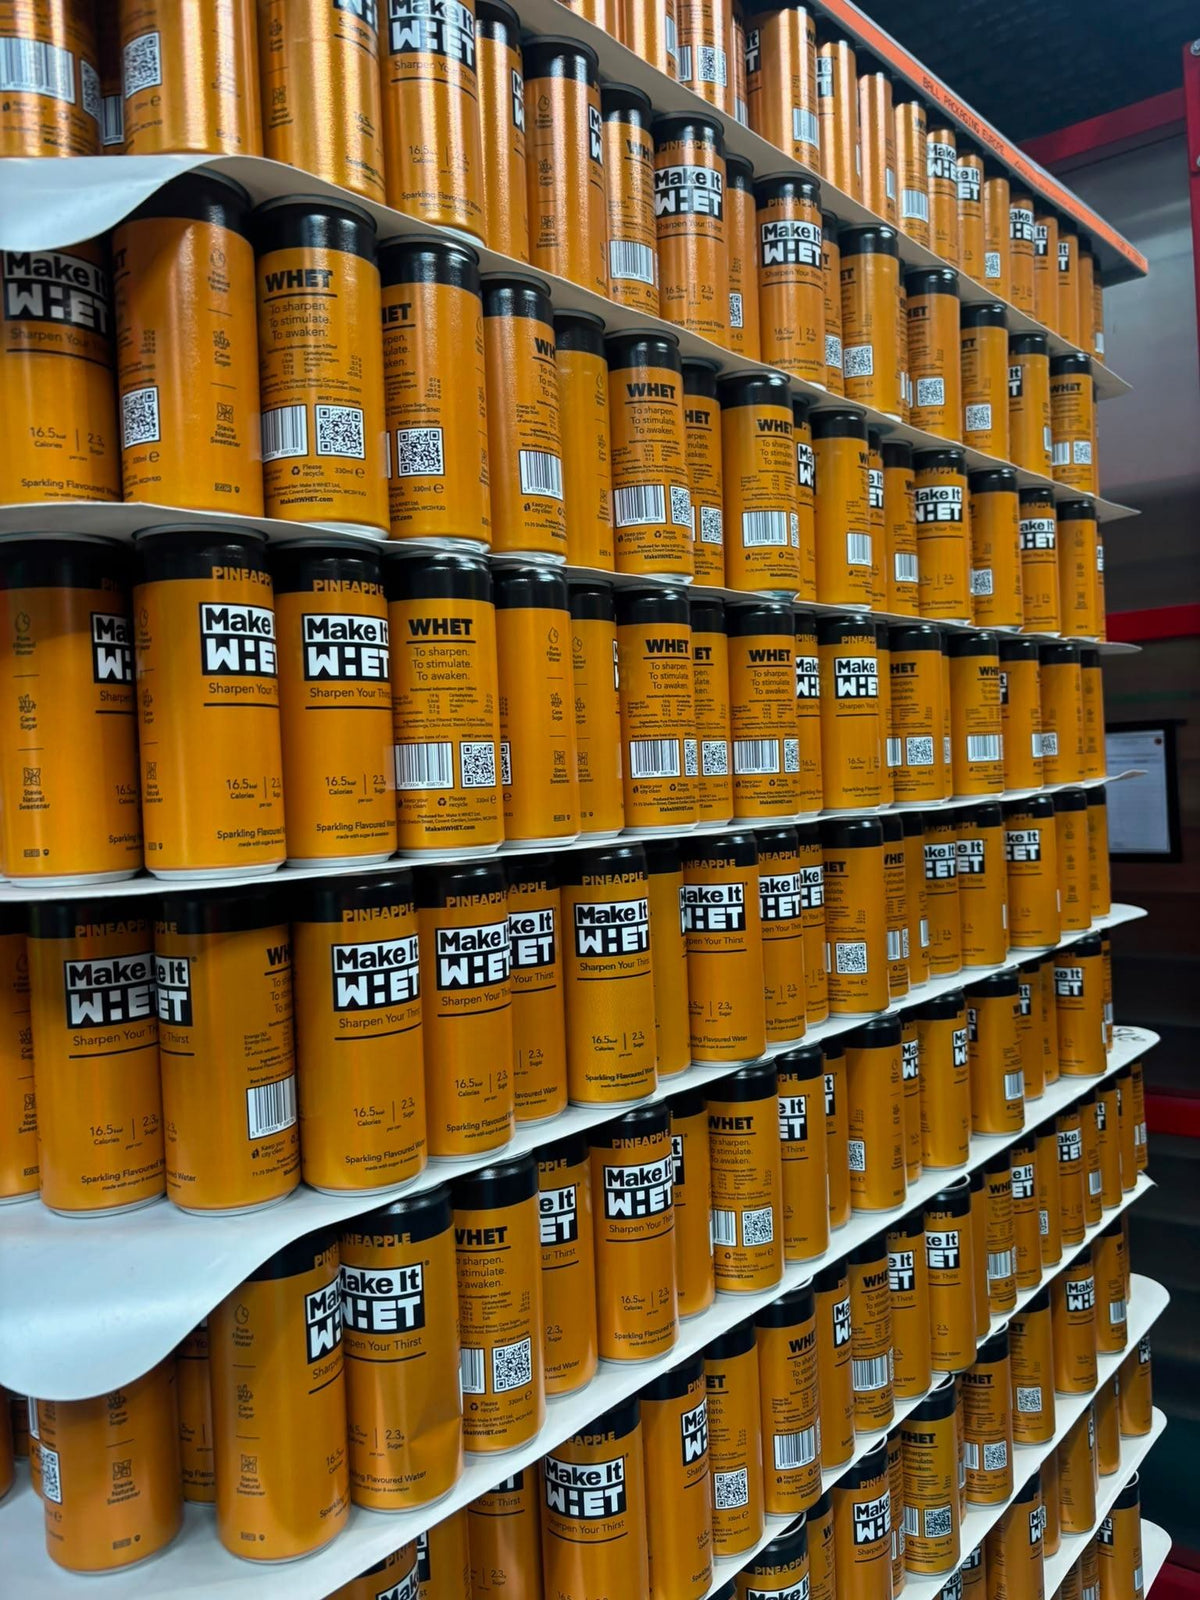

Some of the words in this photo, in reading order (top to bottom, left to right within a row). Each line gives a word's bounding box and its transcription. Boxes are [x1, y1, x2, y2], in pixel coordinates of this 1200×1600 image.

[711, 169, 721, 191] It
[764, 223, 811, 241] Make
[813, 227, 822, 245] It
[6, 251, 91, 287] Make
[265, 269, 334, 293] WHET
[271, 303, 280, 314] To
[283, 301, 329, 314] sharpen.
[270, 318, 279, 328] To
[281, 314, 332, 326] stimulate.
[11, 327, 63, 342] Sharpen
[272, 330, 283, 341] To
[285, 326, 329, 338] awaken.
[626, 383, 676, 399] WHET
[632, 406, 642, 414] To
[631, 417, 641, 425] To
[34, 440, 63, 449] Calories
[21, 478, 64, 490] Sparkling
[66, 480, 105, 494] Flavoured
[952, 489, 960, 500] It
[313, 579, 384, 596] PINEAPPLE
[205, 607, 271, 635] Make
[408, 618, 473, 636] WHET
[307, 617, 377, 641] Make
[380, 621, 389, 643] It
[414, 647, 426, 657] To
[429, 647, 470, 658] sharpen.
[645, 639, 689, 654] WHET
[749, 649, 791, 662] WHET
[412, 659, 424, 669] To
[426, 659, 473, 669] stimulate.
[651, 662, 660, 670] To
[838, 658, 875, 674] Make
[416, 671, 428, 681] To
[431, 670, 470, 680] awaken.
[209, 682, 255, 696] Sharpen
[256, 684, 273, 696] Your
[310, 688, 354, 700] Sharpen
[356, 689, 376, 698] Your
[20, 715, 37, 723] Cane
[20, 722, 38, 731] Sugar
[22, 795, 45, 803] Natural
[230, 792, 255, 800] Calories
[329, 788, 353, 796] Calories
[19, 802, 51, 810] Sweetener
[217, 830, 256, 840] Sparkling
[316, 823, 358, 833] Sparkling
[1026, 832, 1038, 842] It
[970, 842, 982, 853] It
[582, 871, 644, 886] PINEAPPLE
[727, 886, 742, 903] It
[342, 902, 415, 922] PINEAPPLE
[577, 905, 635, 925] Make
[639, 902, 648, 920] It
[540, 913, 552, 932] It
[440, 929, 501, 952] Make
[703, 937, 721, 945] Your
[337, 945, 406, 971] Make
[409, 936, 418, 960] It
[69, 960, 146, 987] Make
[170, 961, 186, 985] It
[580, 961, 617, 972] Sharpen
[618, 961, 635, 969] Your
[514, 975, 533, 983] Your
[535, 971, 554, 981] Thirst
[442, 997, 482, 1007] Sharpen
[484, 993, 500, 1002] Your
[339, 1017, 383, 1030] Sharpen
[385, 1012, 405, 1023] Your
[73, 1032, 121, 1047] Sharpen
[123, 1028, 146, 1040] Your
[585, 1073, 615, 1083] Sparkling
[790, 1097, 804, 1114] It
[612, 1128, 669, 1149] PINEAPPLE
[718, 1138, 750, 1148] sharpen.
[345, 1152, 382, 1164] Sparkling
[384, 1143, 415, 1159] Flavoured
[81, 1170, 122, 1185] Sparkling
[123, 1159, 159, 1178] Flavoured
[608, 1168, 662, 1188] Make
[664, 1160, 672, 1178] It
[558, 1189, 574, 1210] It
[609, 1224, 645, 1235] Sharpen
[646, 1220, 662, 1230] Your
[946, 1233, 957, 1246] It
[554, 1249, 575, 1260] Thirst
[901, 1254, 912, 1267] It
[463, 1256, 504, 1268] sharpen.
[461, 1267, 506, 1278] stimulate.
[400, 1269, 419, 1293] It
[465, 1280, 504, 1289] awaken.
[614, 1331, 643, 1341] Sparkling
[368, 1341, 391, 1352] Your
[394, 1338, 422, 1350] Thirst
[387, 1442, 404, 1450] Sugar
[367, 1475, 403, 1484] Flavoured
[405, 1471, 427, 1482] Water
[546, 1458, 601, 1486] Make
[606, 1461, 622, 1483] It
[580, 1525, 600, 1535] Your
[602, 1520, 625, 1532] Thirst
